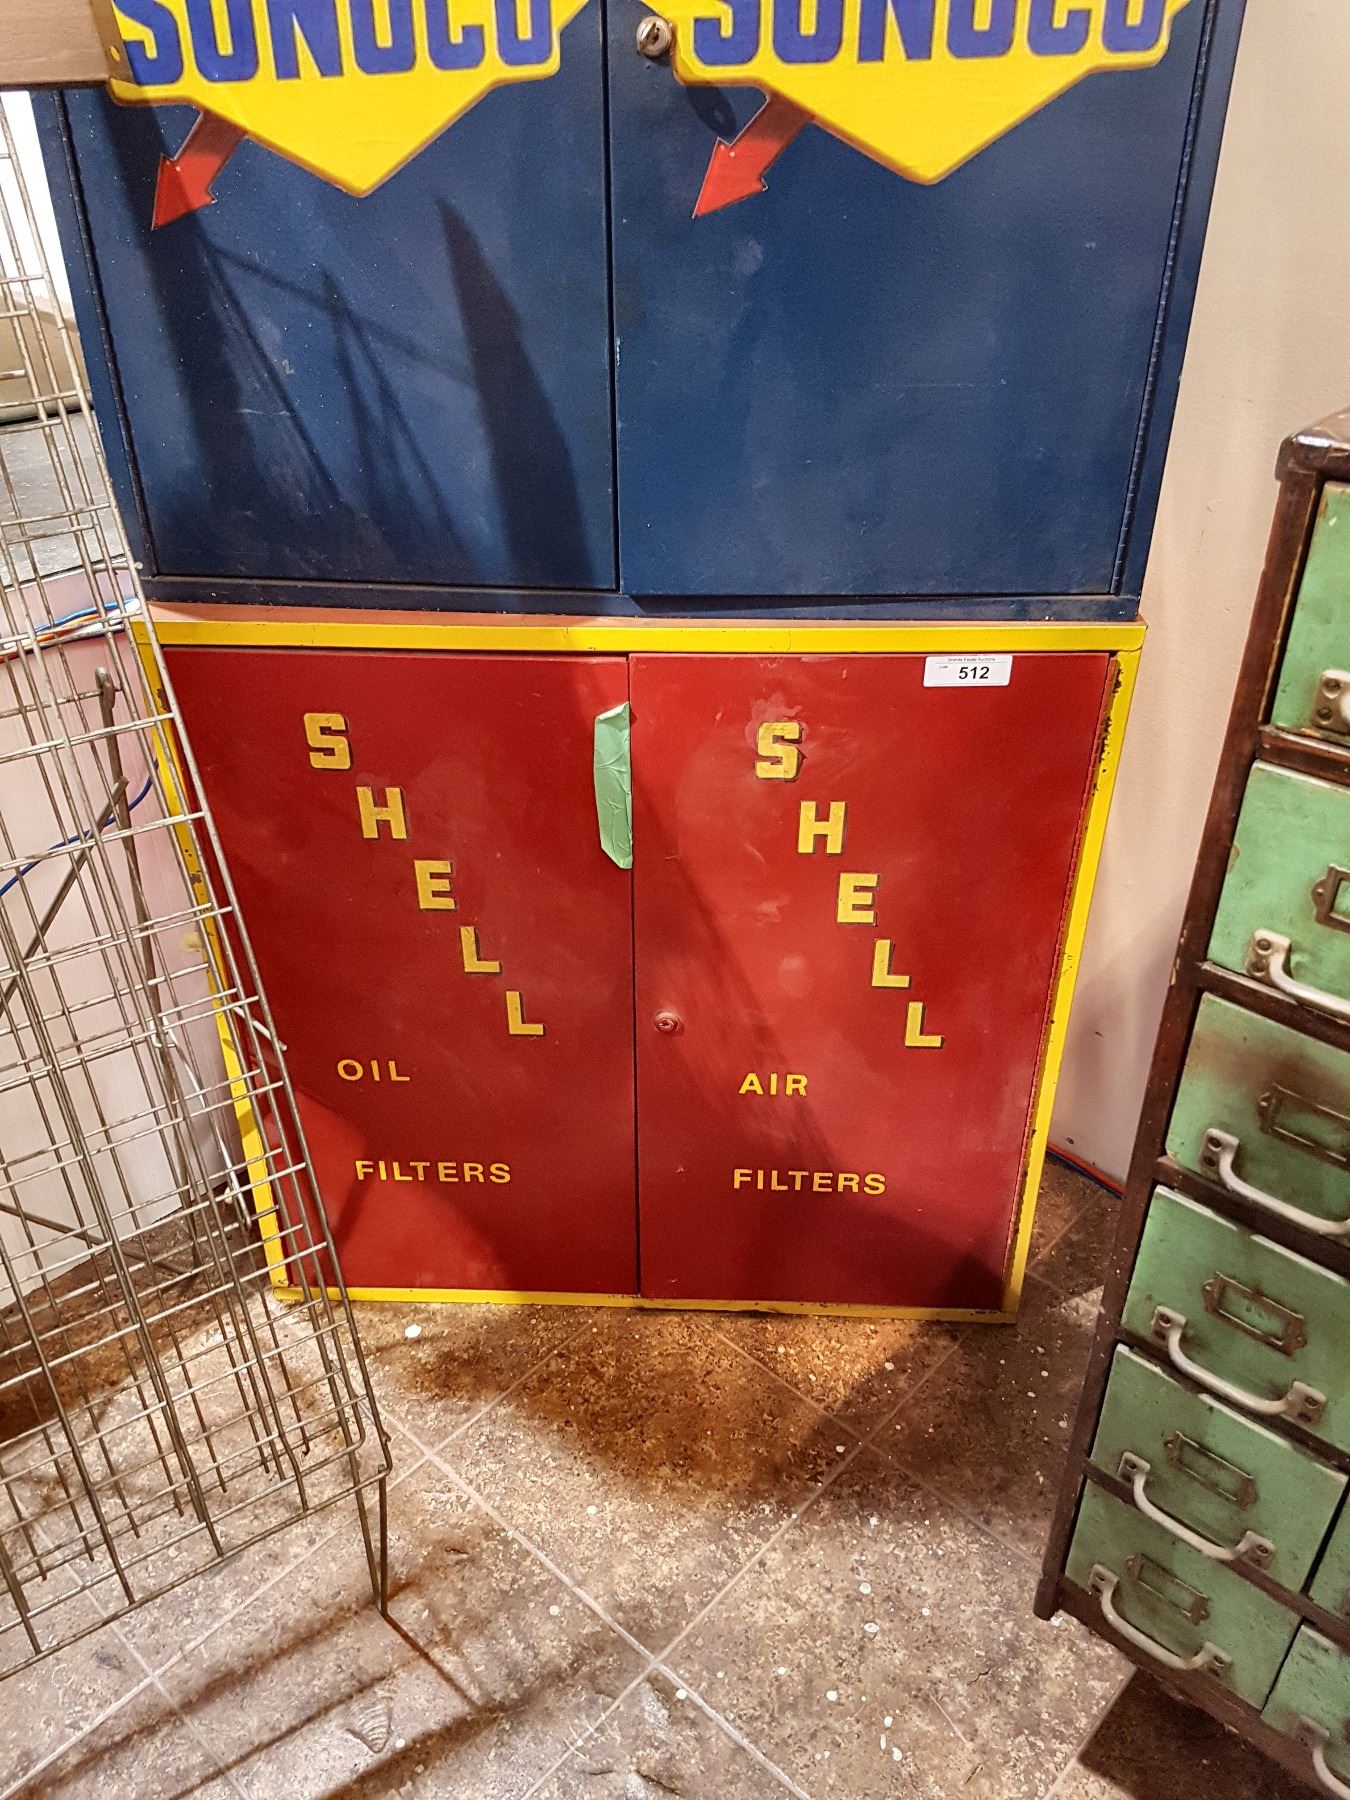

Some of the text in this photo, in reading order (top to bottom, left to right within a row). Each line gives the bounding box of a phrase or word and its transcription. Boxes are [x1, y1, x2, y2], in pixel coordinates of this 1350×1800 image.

[958, 666, 990, 680] 512
[337, 1059, 411, 1081] OIL
[738, 1072, 808, 1097] AIR
[355, 1160, 511, 1184] FILTERS
[733, 1168, 886, 1195] FILTERS
